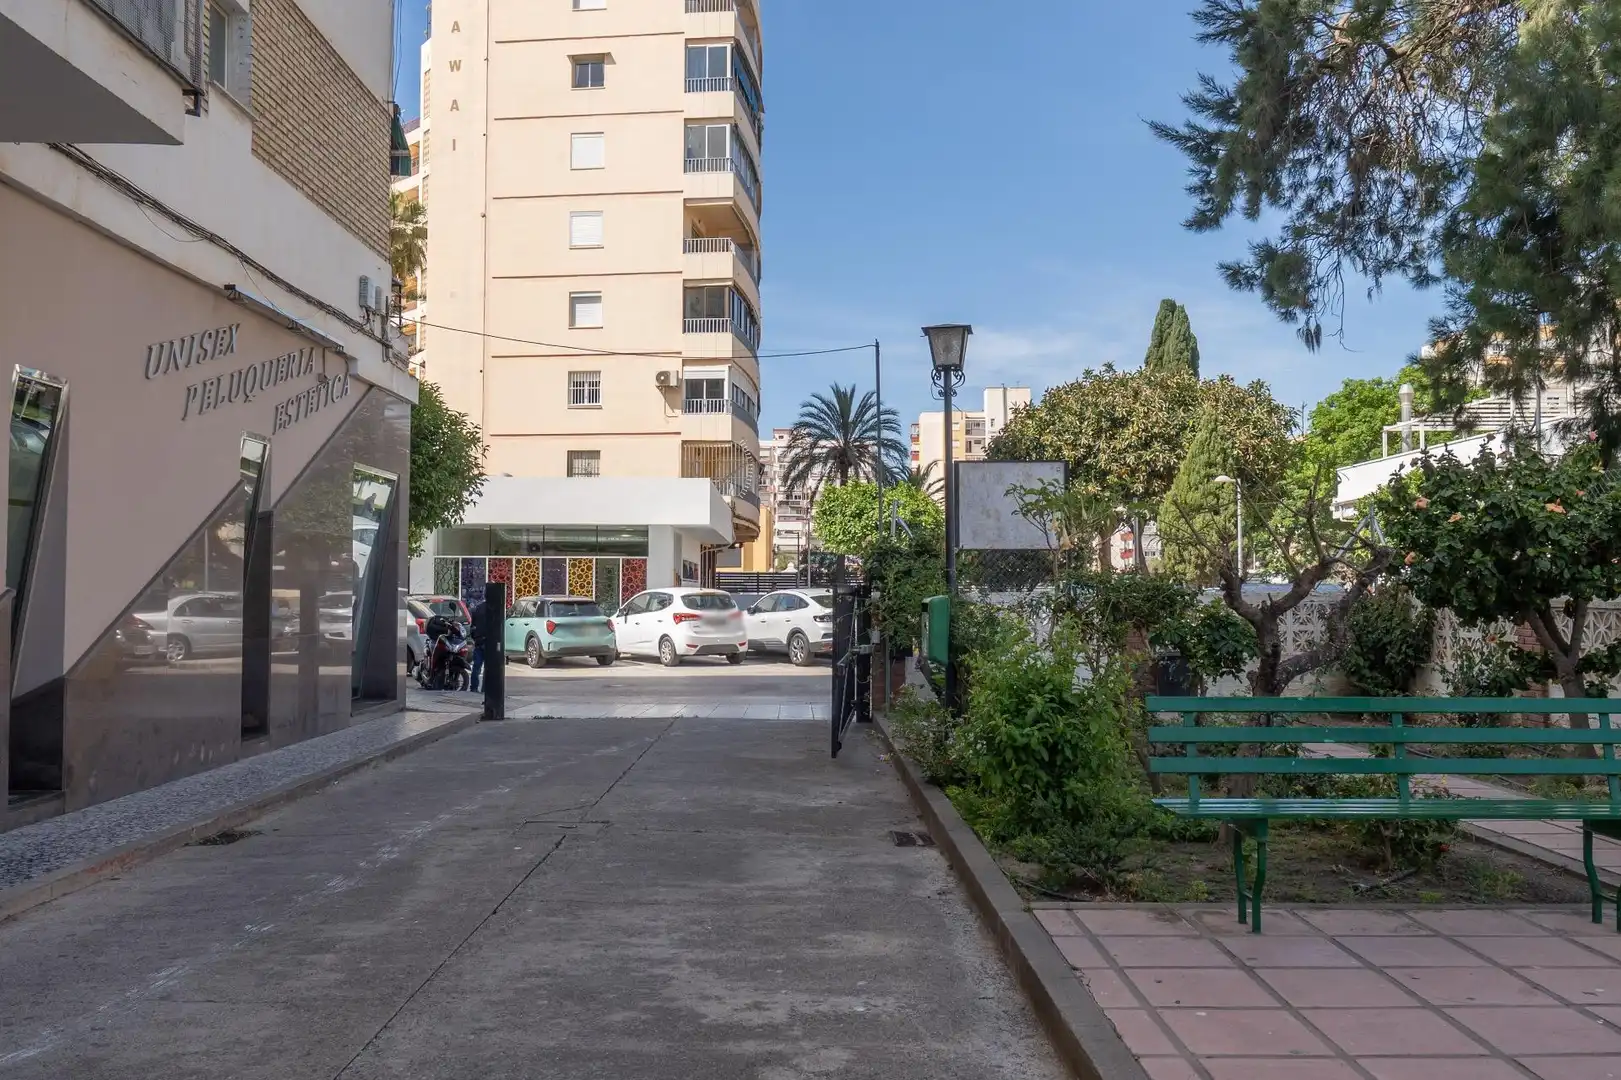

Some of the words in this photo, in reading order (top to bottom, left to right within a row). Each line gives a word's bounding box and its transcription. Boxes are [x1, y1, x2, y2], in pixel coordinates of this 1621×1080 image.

[145, 323, 241, 379] UNISEX
[181, 347, 316, 421] PELUQUERIA
[273, 373, 351, 435] ESTETICA
